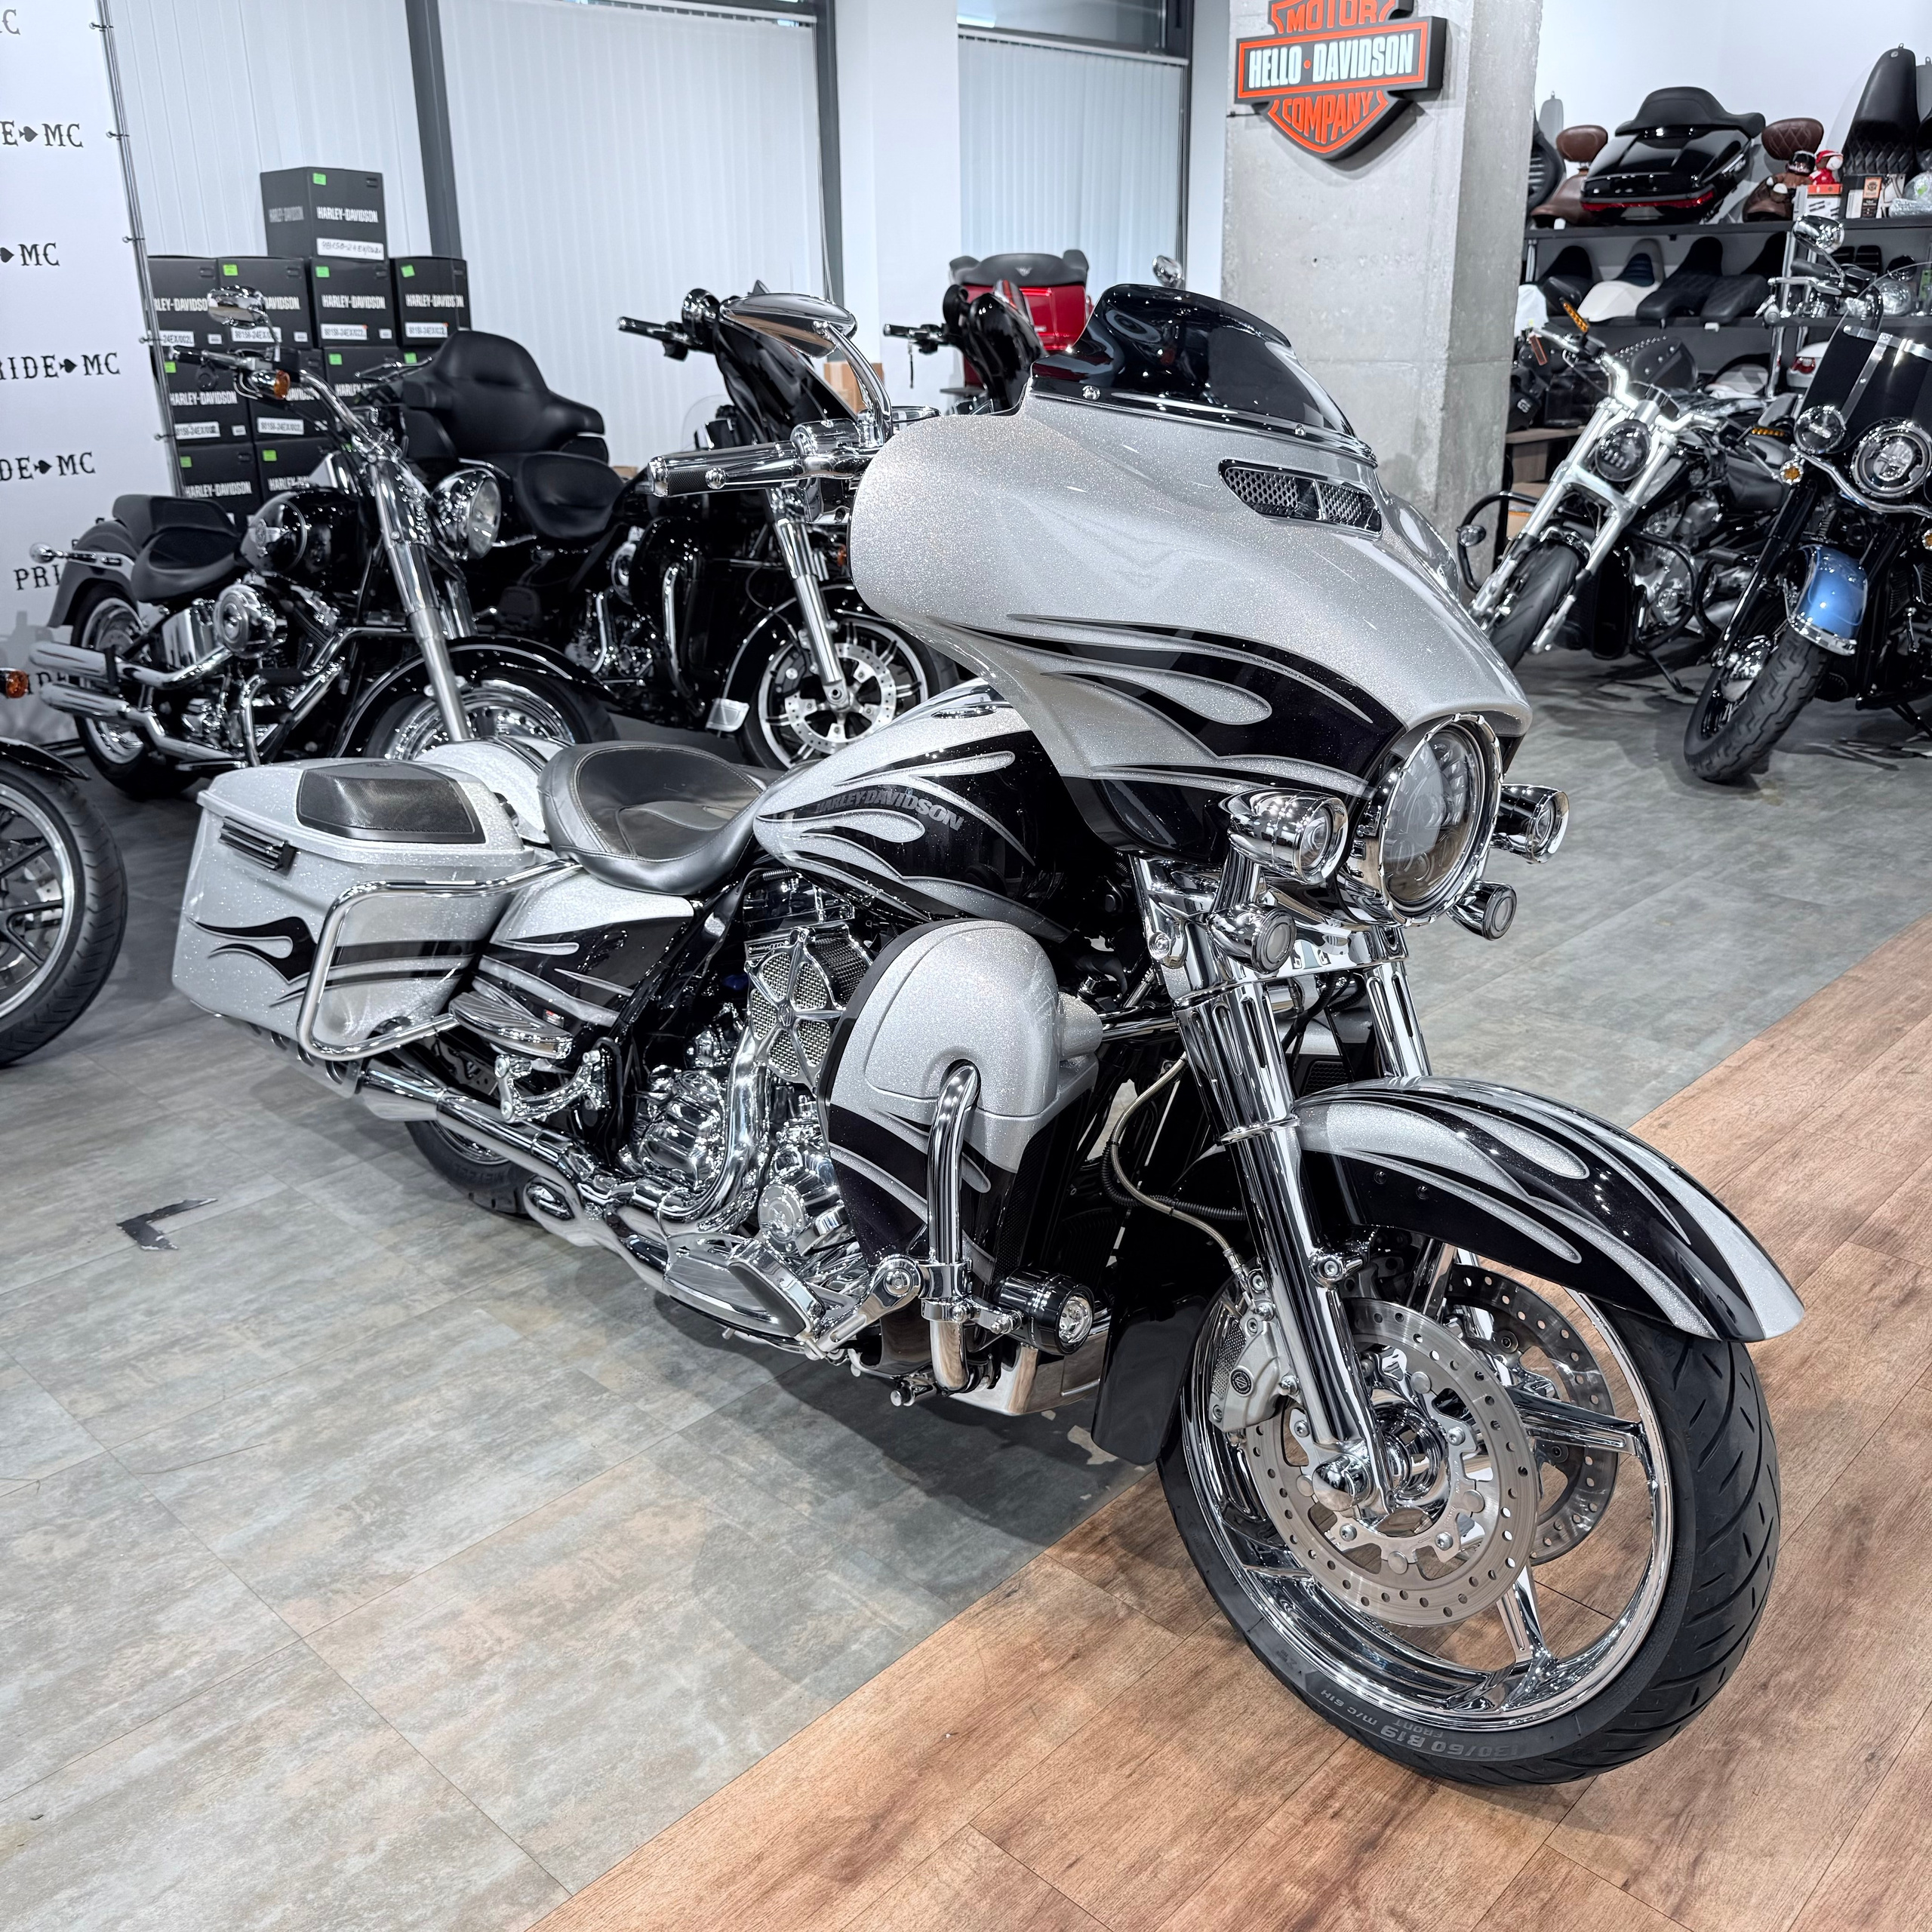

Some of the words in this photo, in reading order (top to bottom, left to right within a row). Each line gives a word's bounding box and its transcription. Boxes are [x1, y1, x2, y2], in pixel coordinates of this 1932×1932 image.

[1248, 45, 1303, 88] HELLO
[1312, 33, 1414, 82] DAVIDSON
[1282, 91, 1374, 144] COMPANY
[42, 123, 84, 148] MC
[316, 206, 380, 223] HARLEY-DAVIDSON
[18, 242, 60, 266] MC
[321, 294, 386, 309] HARLEY-DAVIDSON
[81, 352, 121, 376] MC
[170, 390, 238, 406] HARLEY-DAVIDSON
[56, 451, 96, 476] MC
[816, 789, 964, 831] HARLEY-DAVIDSON
[1380, 1724, 1426, 1748] B19
